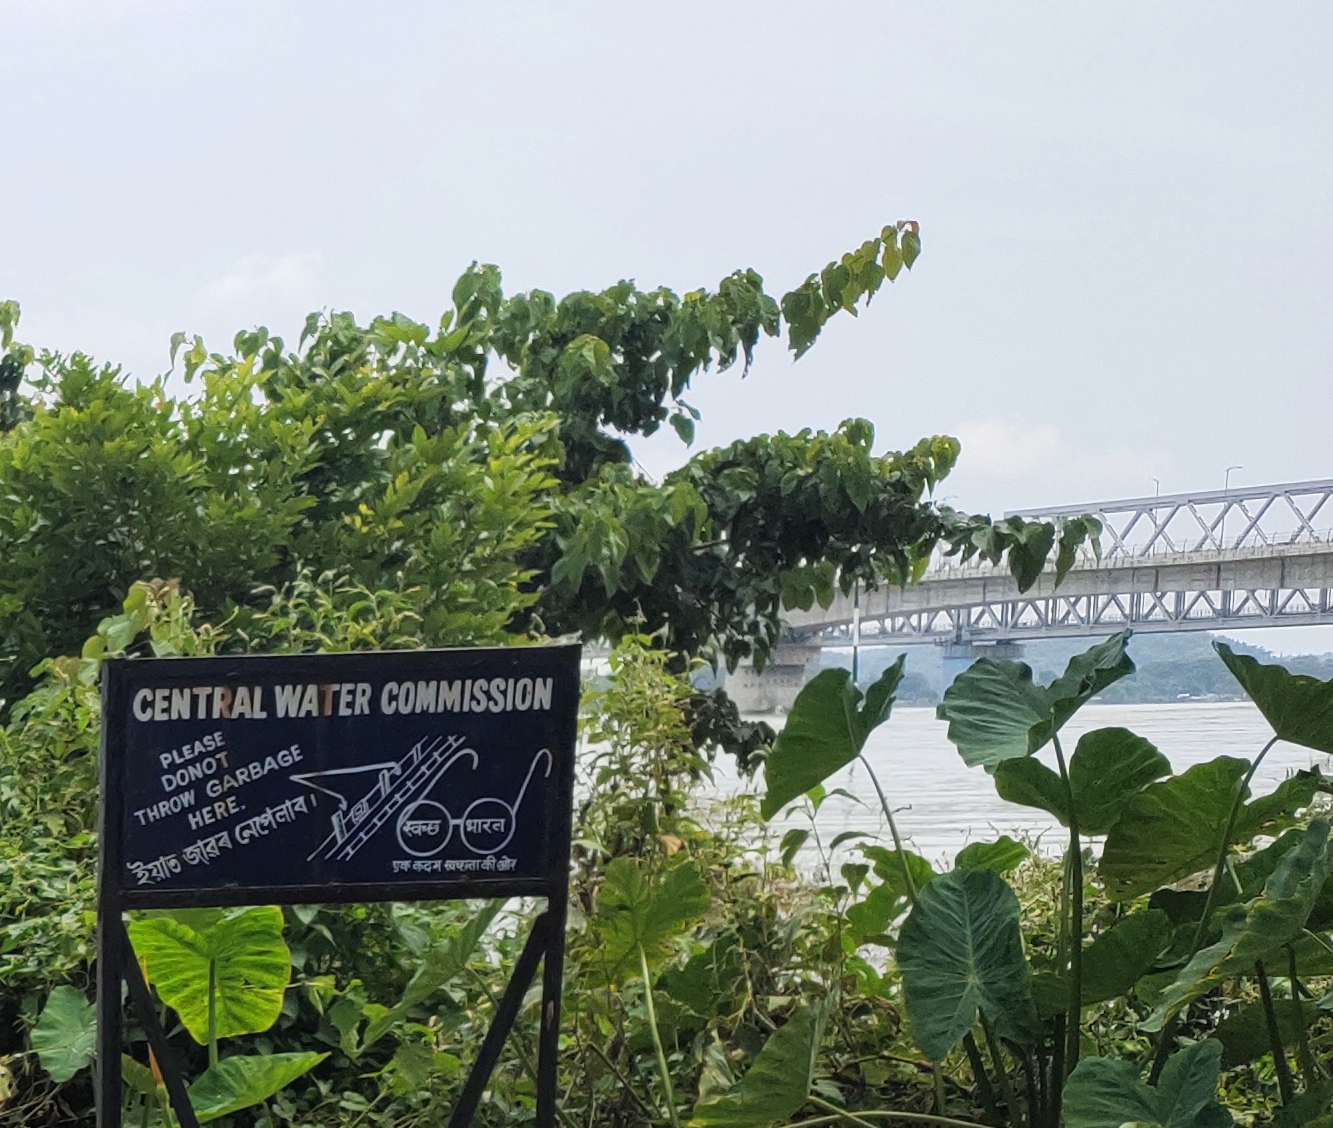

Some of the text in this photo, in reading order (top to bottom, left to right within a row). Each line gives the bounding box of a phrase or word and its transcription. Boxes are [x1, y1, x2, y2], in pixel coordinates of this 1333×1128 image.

[132, 677, 554, 722] CENTRAL WATER COMMISSION
[159, 731, 226, 769] PLEASE
[133, 744, 304, 826] THROW GARBAGE
[160, 751, 229, 792] DONOT
[188, 795, 246, 830] HERE.
[402, 818, 506, 837] स्वच्छ भारत
[393, 860, 412, 873] एक
[412, 860, 443, 873] कदम
[481, 855, 497, 872] की
